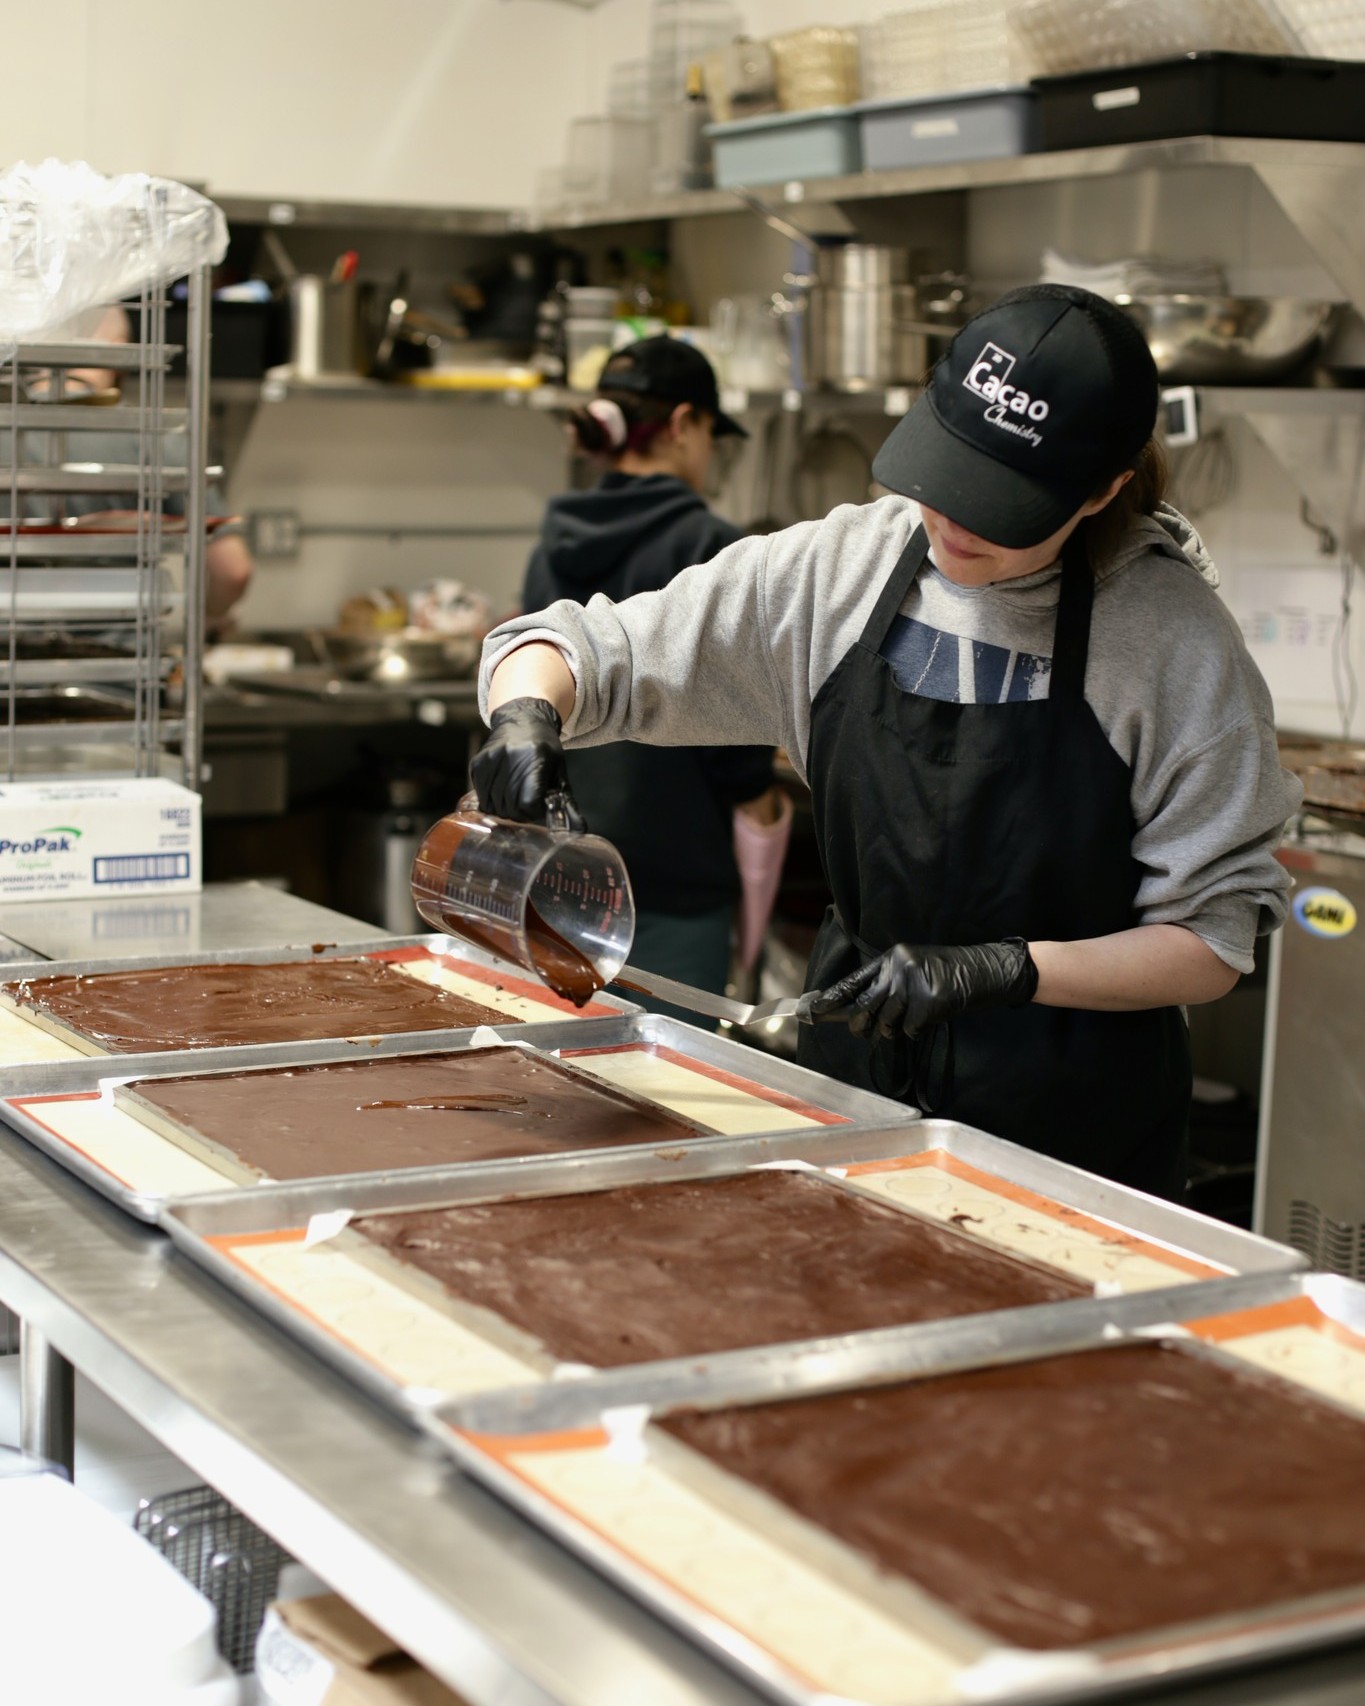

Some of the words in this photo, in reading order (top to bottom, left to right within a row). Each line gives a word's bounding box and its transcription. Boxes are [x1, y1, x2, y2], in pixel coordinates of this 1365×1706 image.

[969, 361, 1049, 421] Cacao
[983, 404, 1043, 447] Chemistry
[0, 838, 70, 854] ProPak
